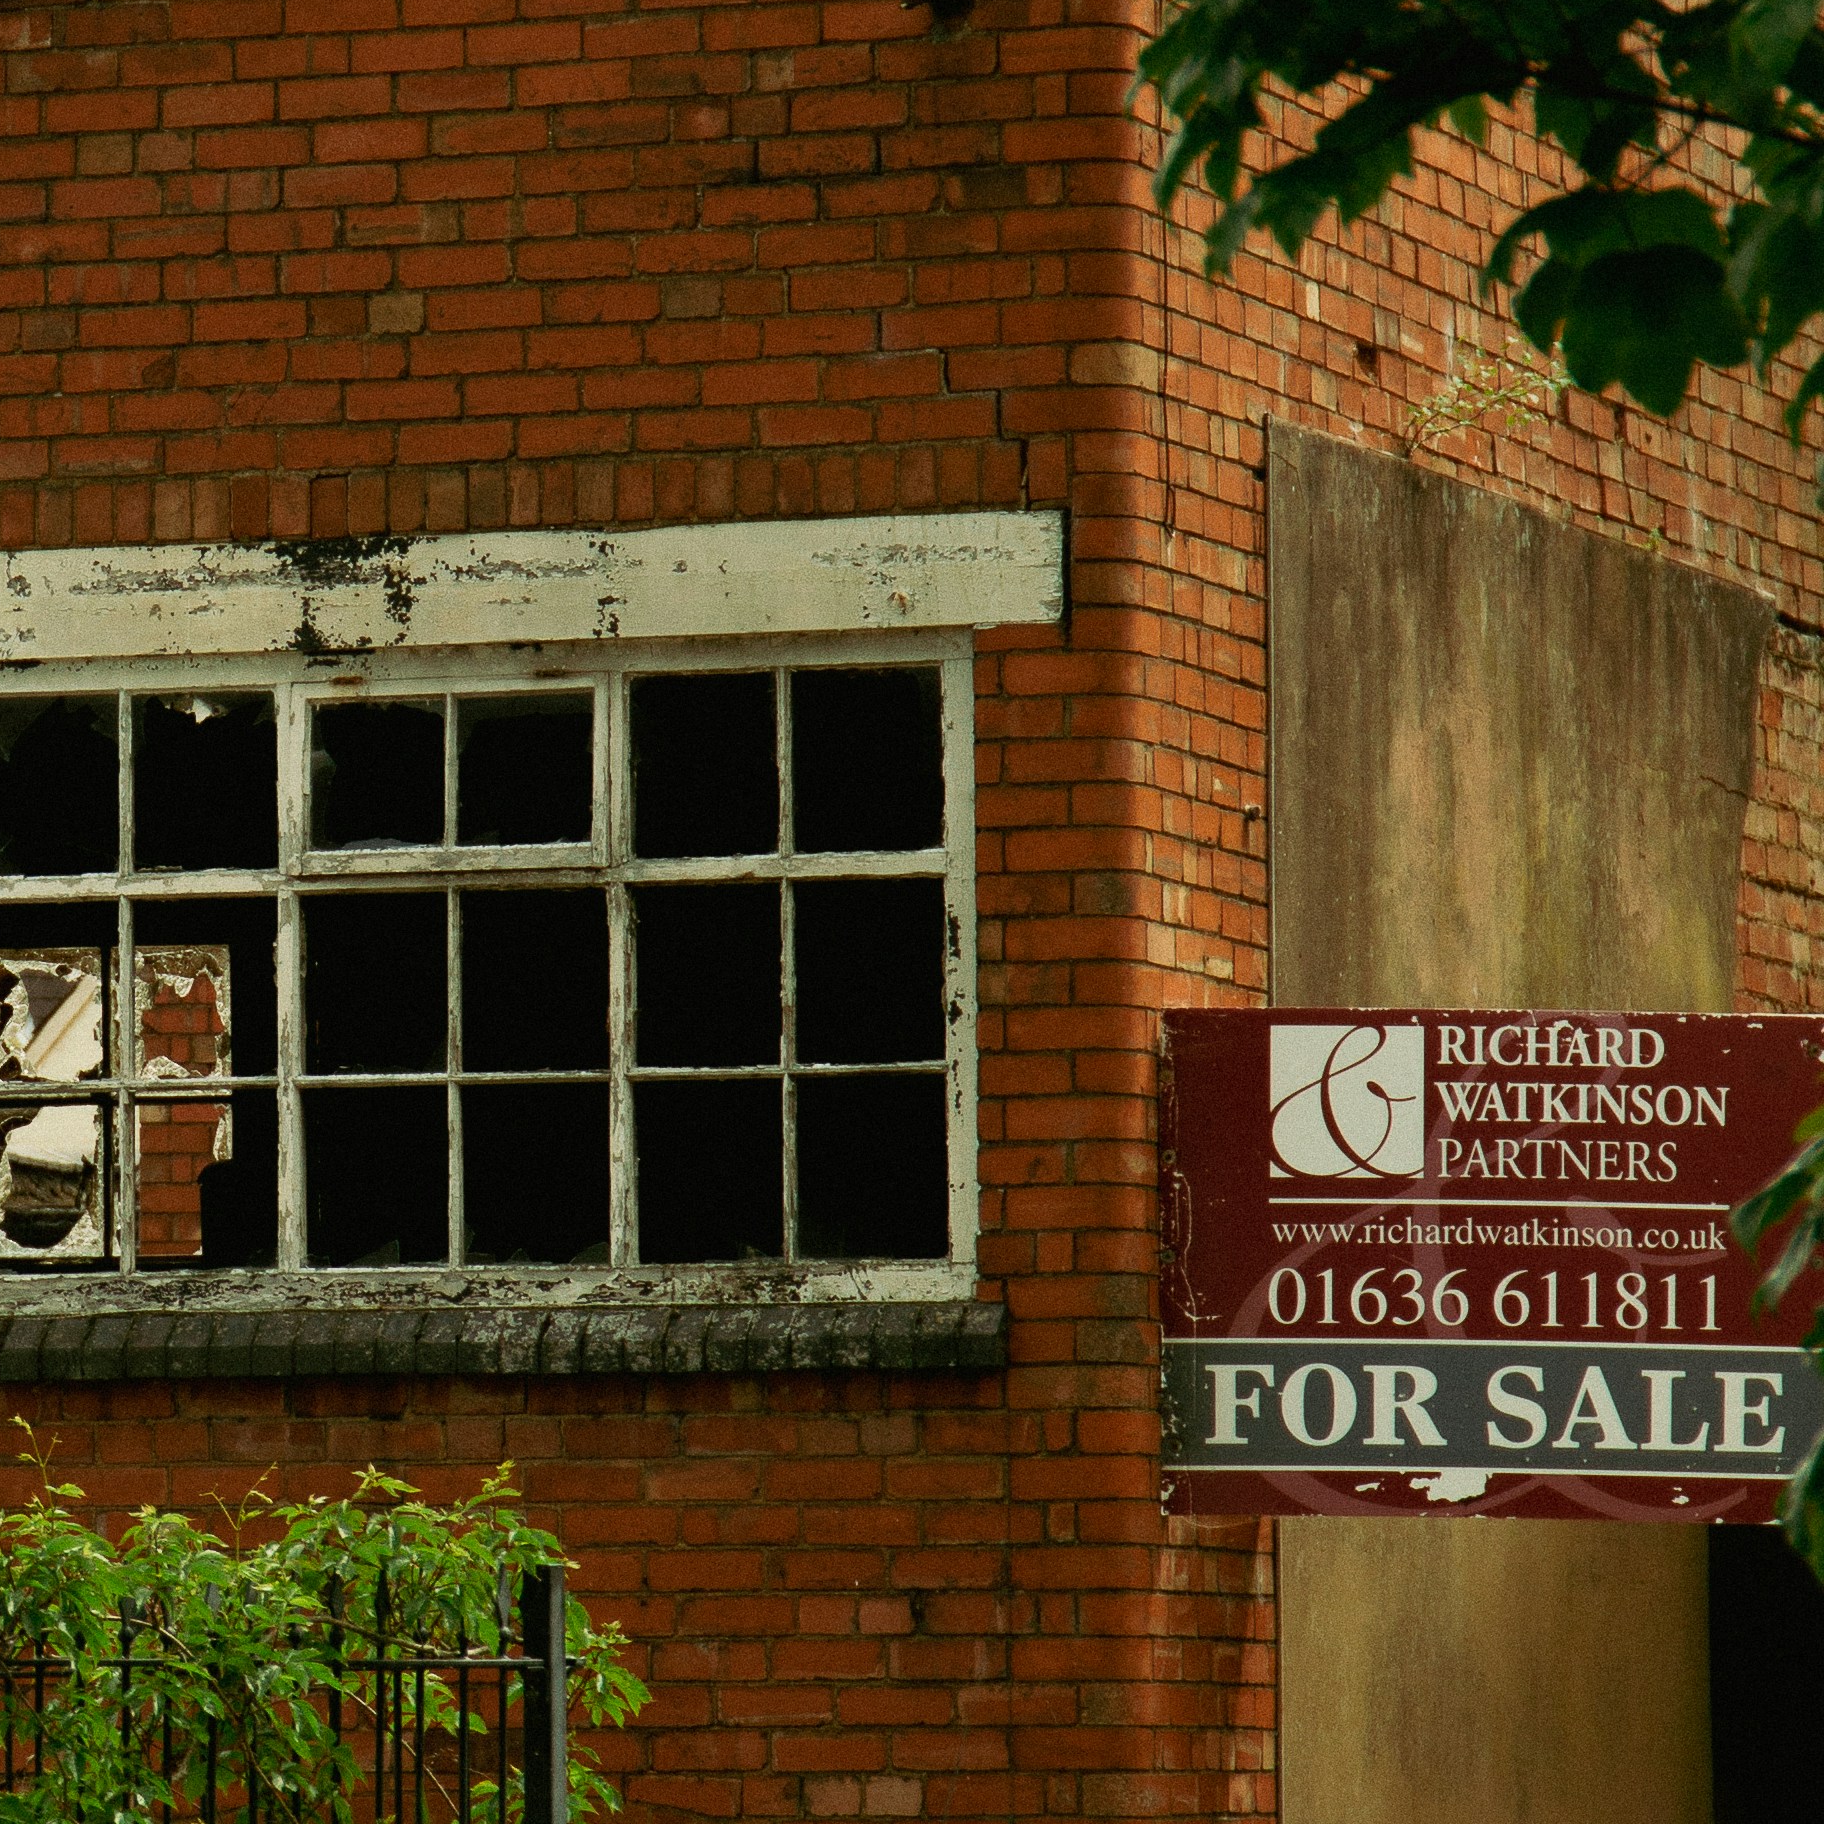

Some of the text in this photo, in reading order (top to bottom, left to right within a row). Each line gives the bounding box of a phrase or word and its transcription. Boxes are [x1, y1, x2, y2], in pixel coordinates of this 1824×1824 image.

[1437, 1025, 1666, 1069] RICHARD
[1435, 1081, 1730, 1127] WATKINSON
[1437, 1138, 1678, 1182] PARTNERS
[1272, 1216, 1728, 1252] www.richardwatkinson.co.uk
[1268, 1267, 1723, 1331] 01636 611811
[1205, 1362, 1786, 1454] FOR SALE
